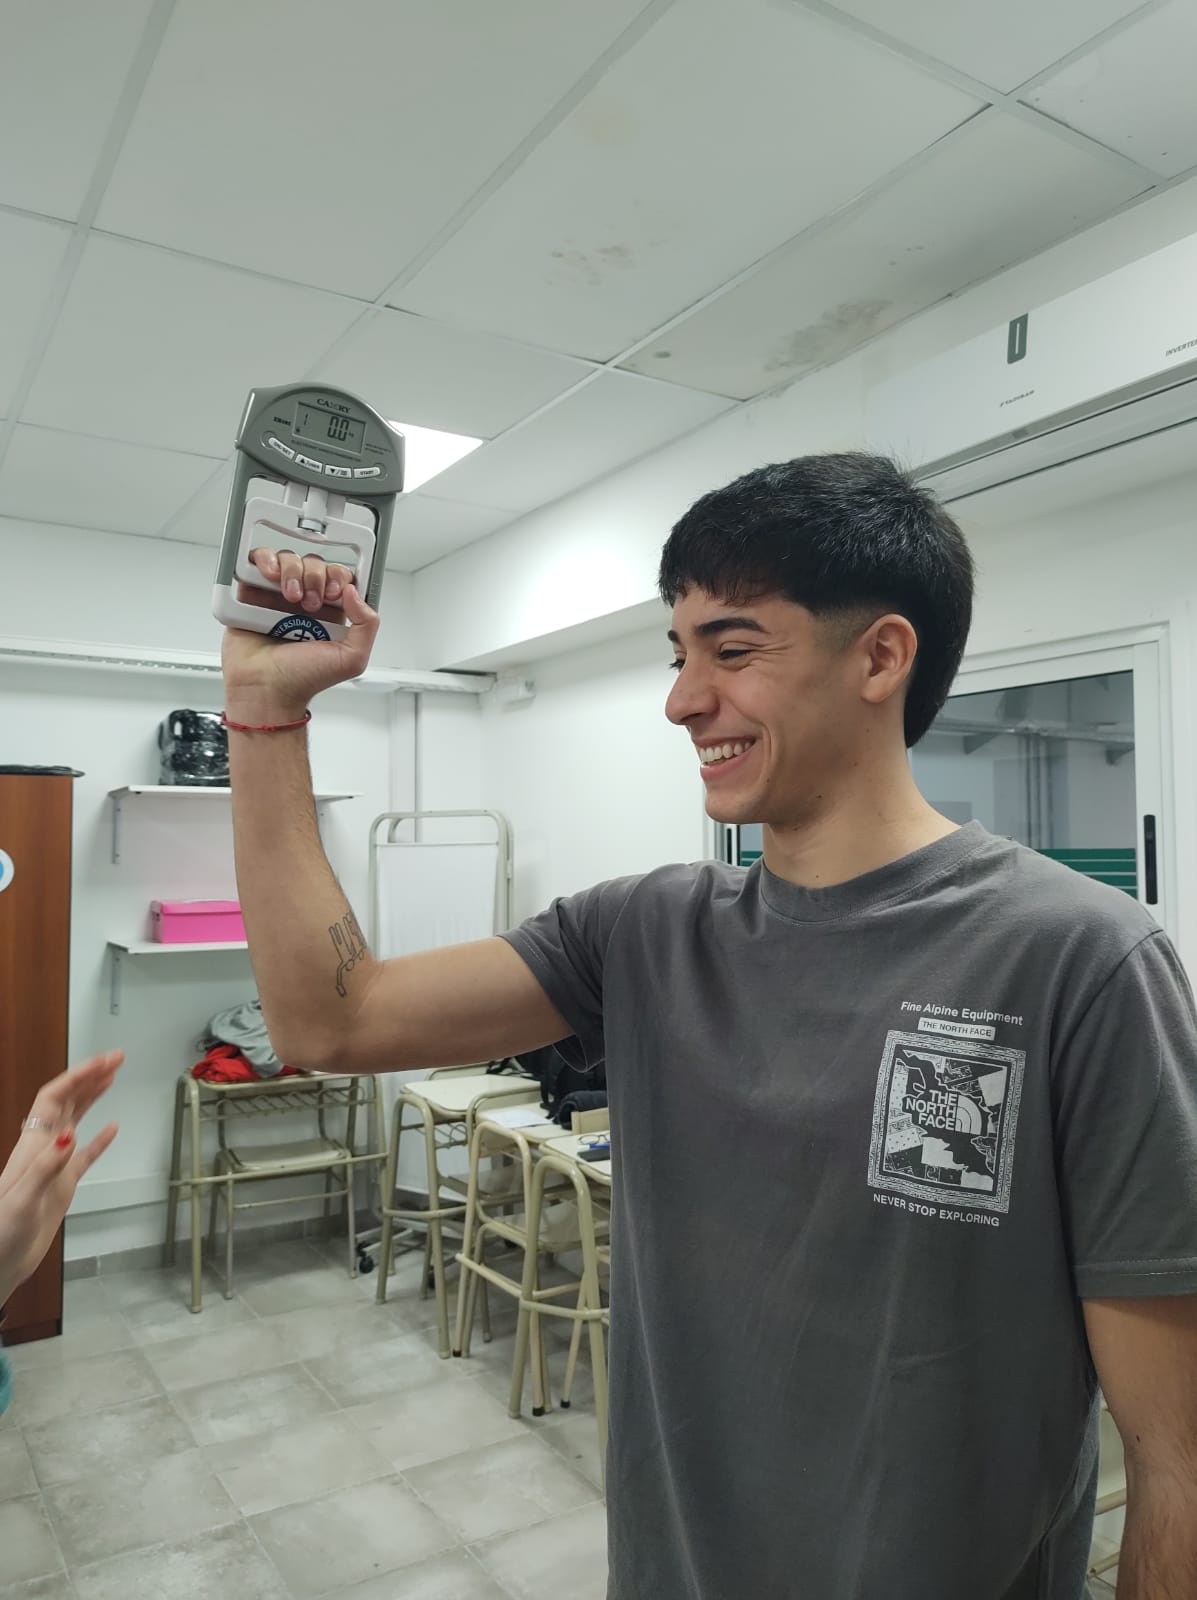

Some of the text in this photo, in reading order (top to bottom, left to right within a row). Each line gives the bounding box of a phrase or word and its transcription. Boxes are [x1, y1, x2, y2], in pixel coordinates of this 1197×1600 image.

[327, 416, 350, 442] 0.0
[312, 625, 328, 641] CAT
[900, 1001, 1024, 1026] Fine Alpine Equipment
[922, 1021, 992, 1037] THE NORTH FACE
[906, 1097, 957, 1118] NORTH
[929, 1089, 958, 1106] THE
[918, 1112, 955, 1131] FACE
[873, 1193, 1000, 1227] NEVER STOP EXPLORING
